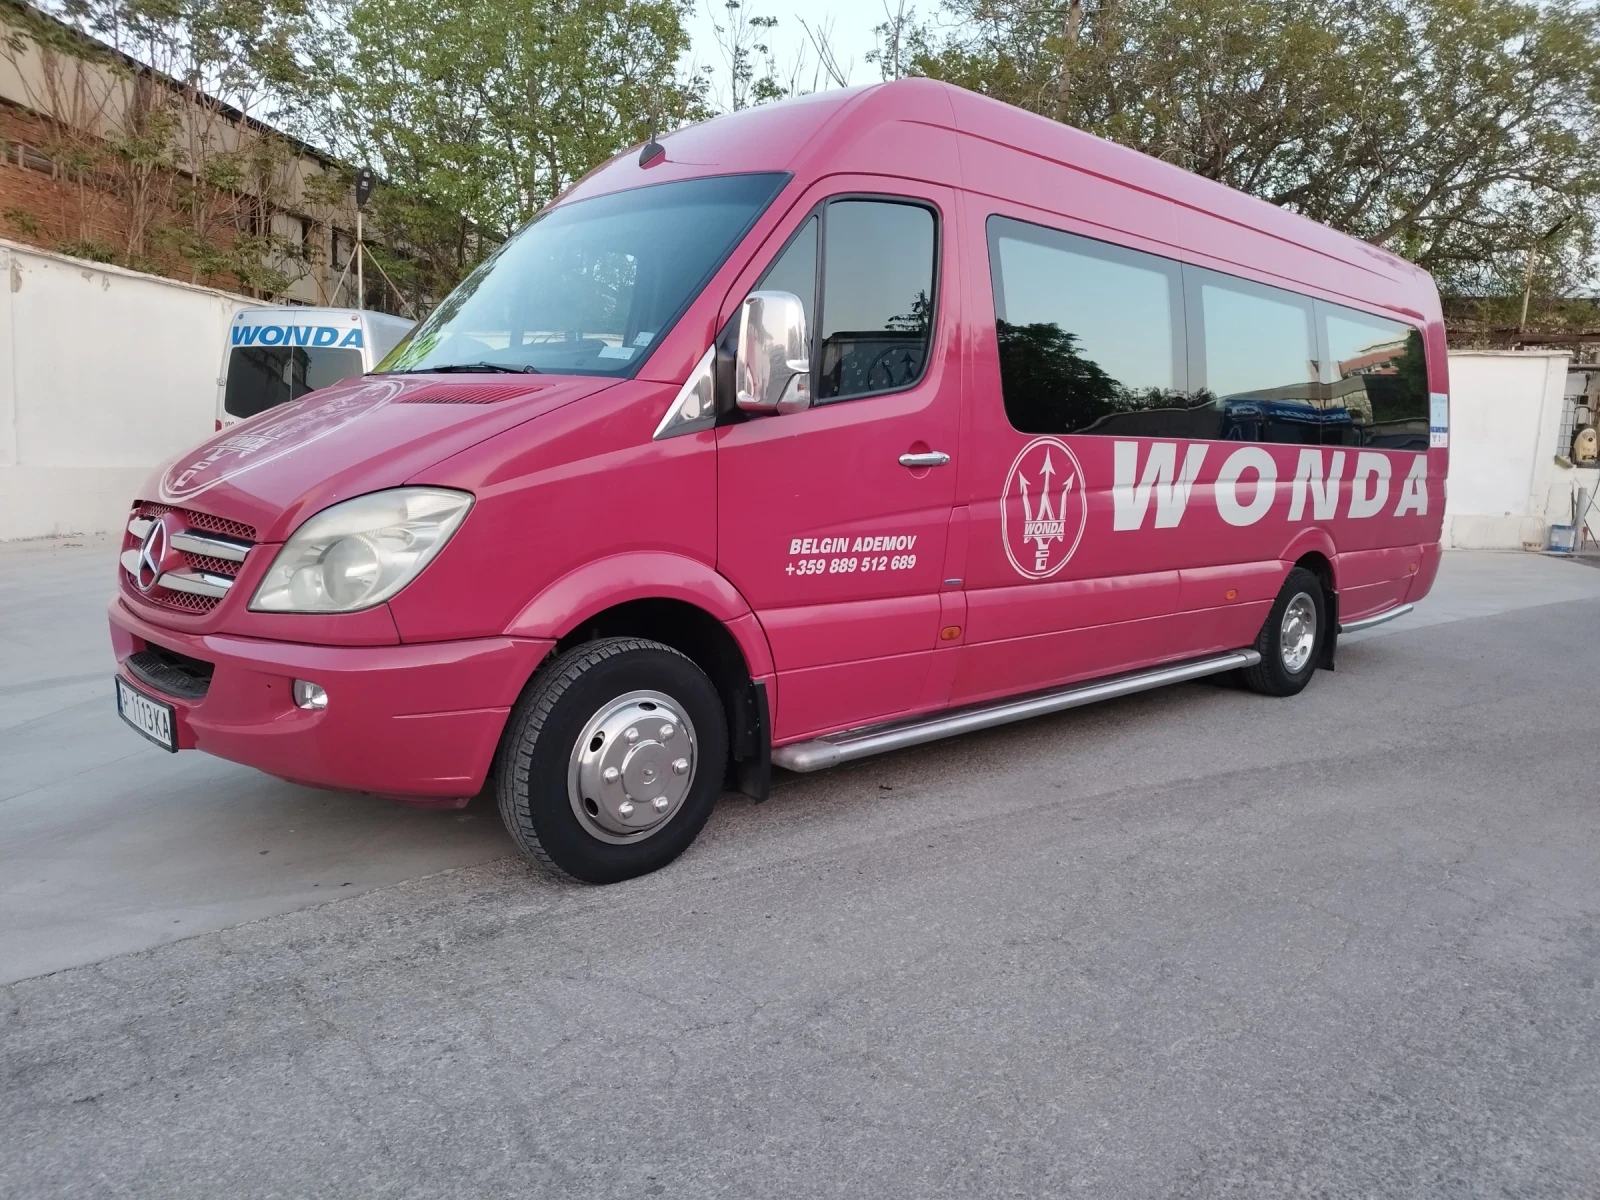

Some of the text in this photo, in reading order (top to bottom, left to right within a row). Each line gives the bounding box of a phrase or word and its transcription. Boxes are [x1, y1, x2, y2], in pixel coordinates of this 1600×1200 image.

[232, 326, 363, 348] WONDA
[1112, 441, 1428, 531] WONDA
[1024, 522, 1065, 535] WONDA
[789, 535, 917, 554] BELGIN ADEMOV
[785, 554, 917, 576] +359 889 512 689
